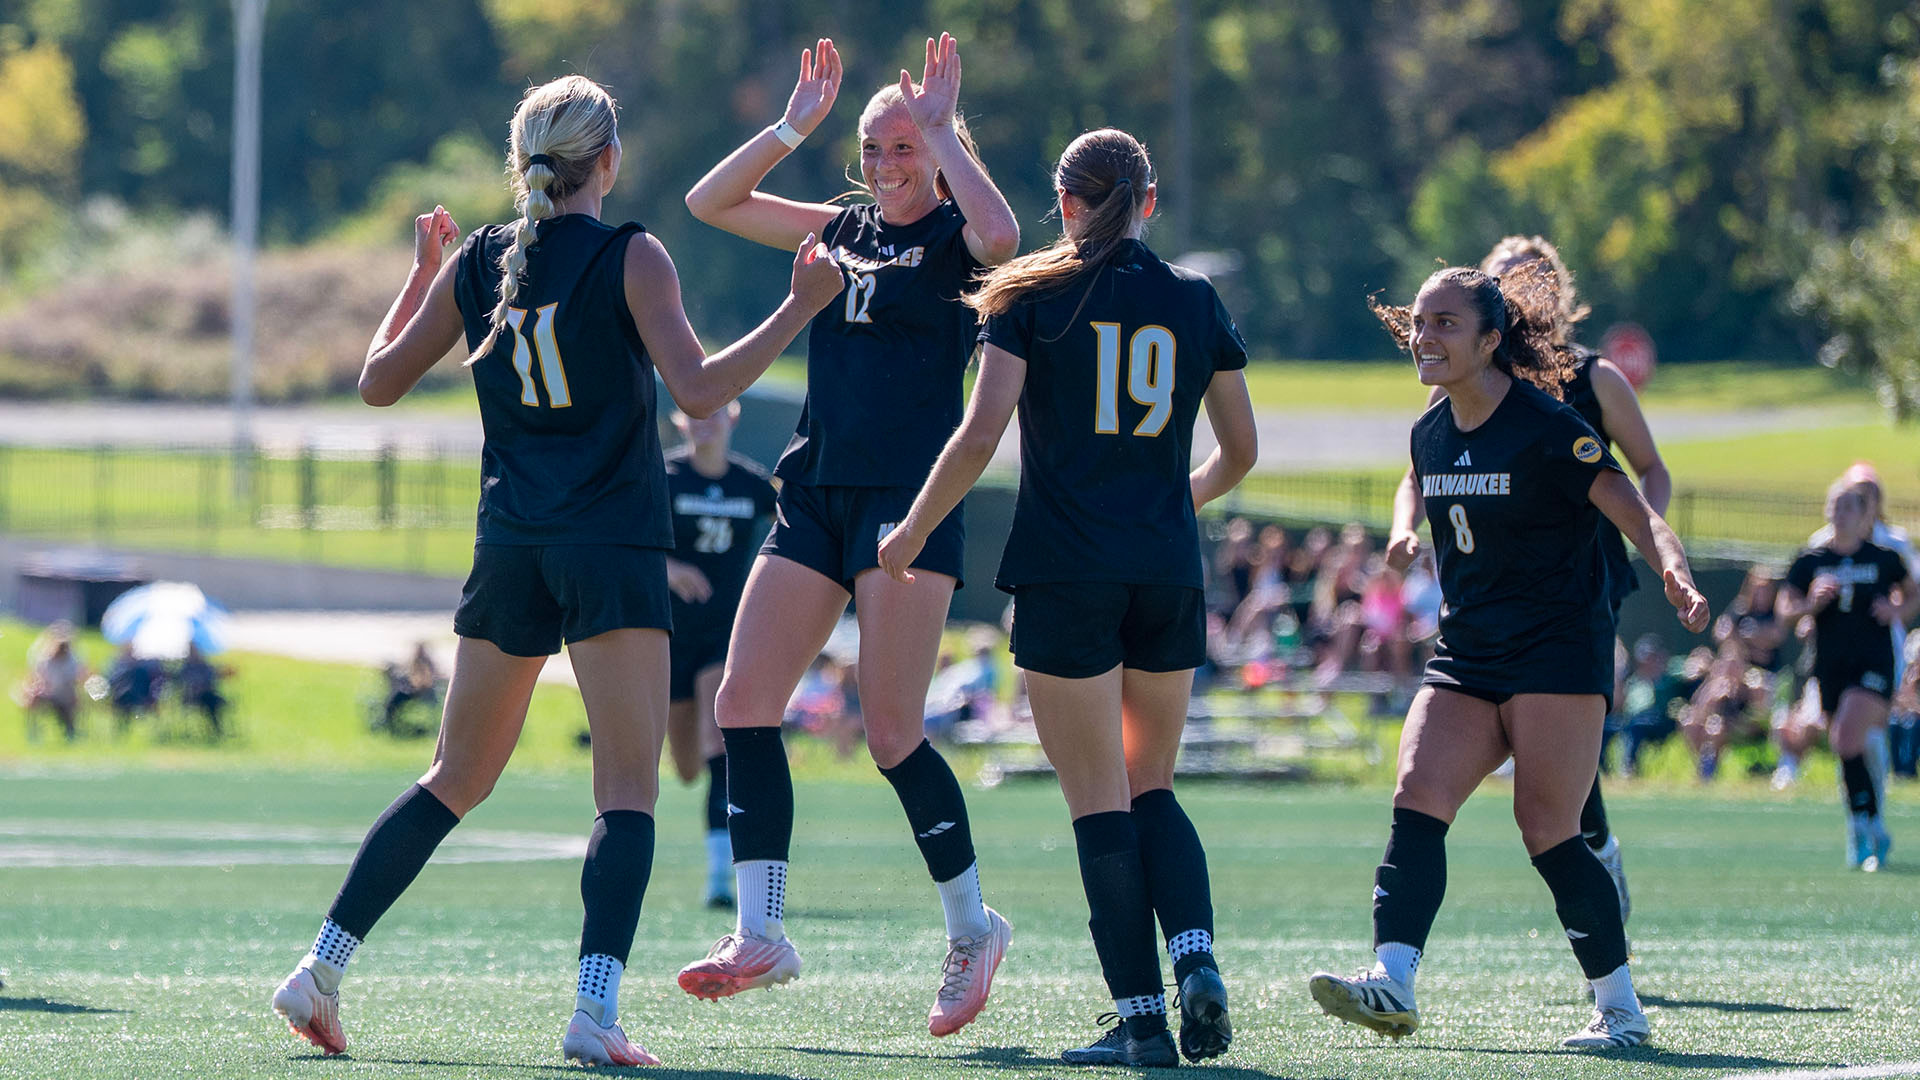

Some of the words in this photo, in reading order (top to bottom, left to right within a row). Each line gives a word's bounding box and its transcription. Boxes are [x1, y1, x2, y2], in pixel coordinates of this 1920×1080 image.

[845, 270, 877, 324] 12
[505, 301, 573, 409] 11
[1089, 321, 1177, 437] 19
[1448, 503, 1475, 555] 8
